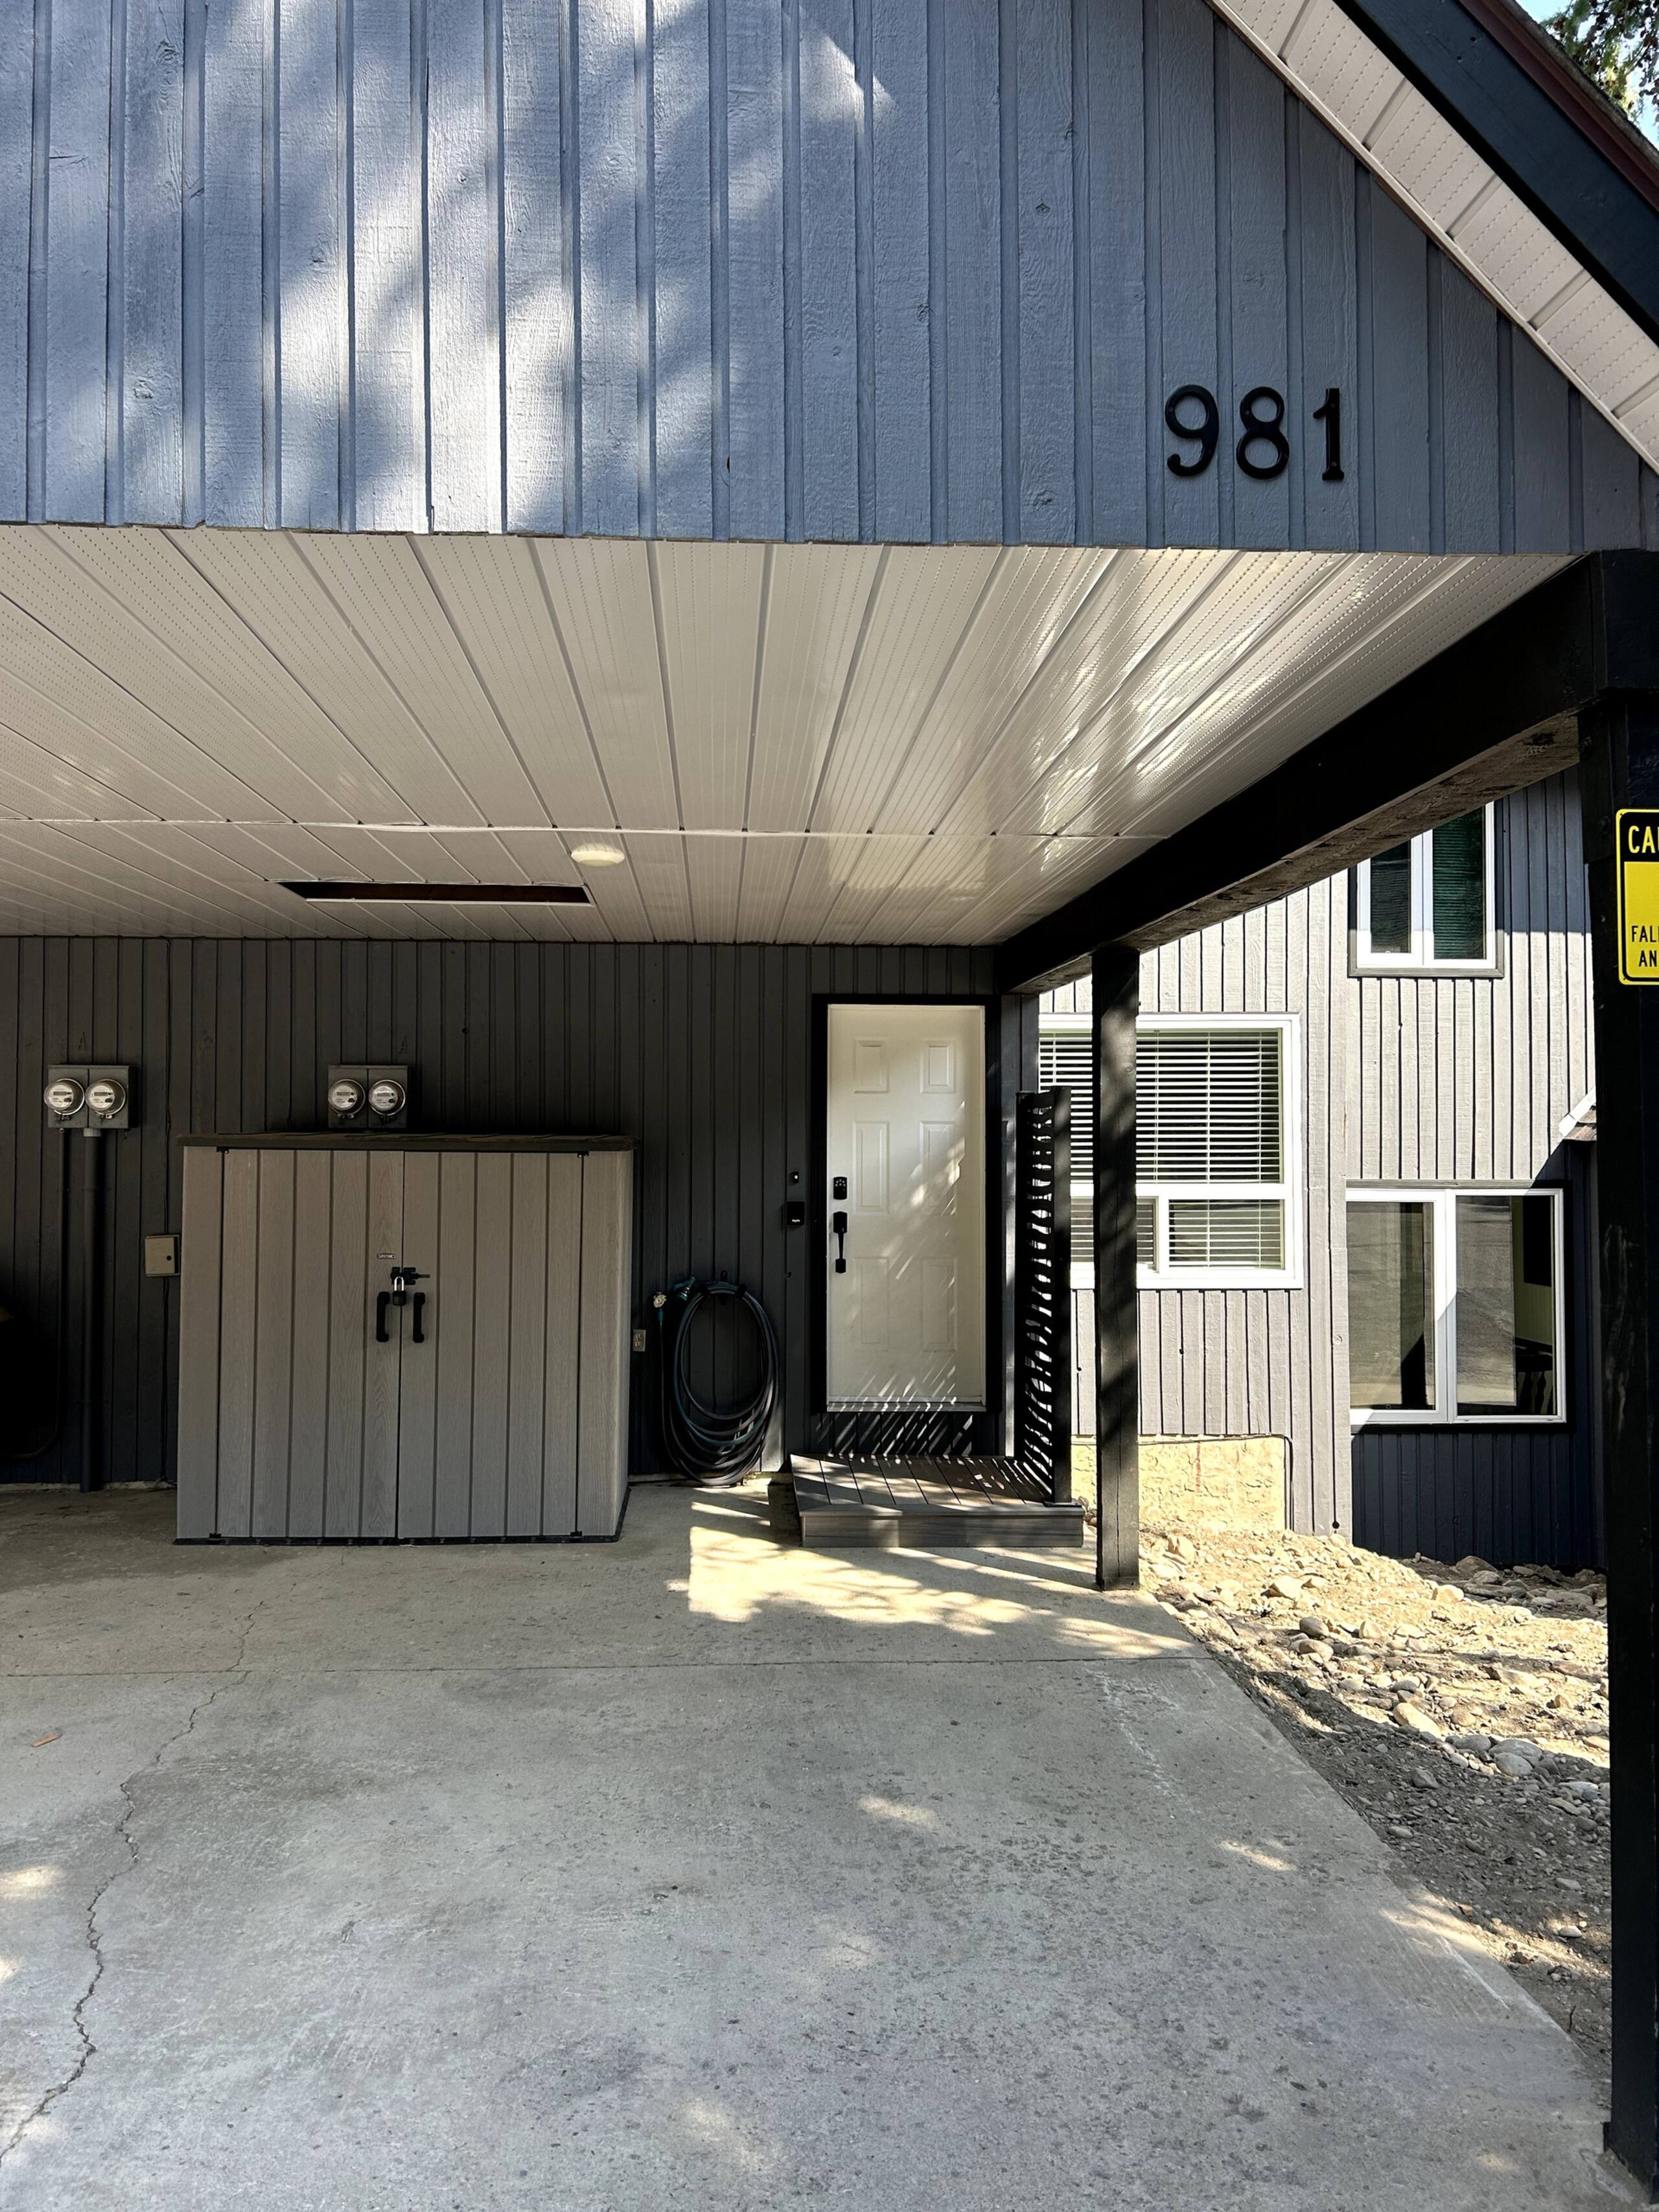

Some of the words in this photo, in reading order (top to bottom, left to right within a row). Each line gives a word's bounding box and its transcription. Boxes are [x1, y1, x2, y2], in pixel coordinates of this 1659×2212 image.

[1165, 384, 1345, 480] 981
[1629, 825, 1659, 854] CA
[1632, 925, 1659, 942] FAL
